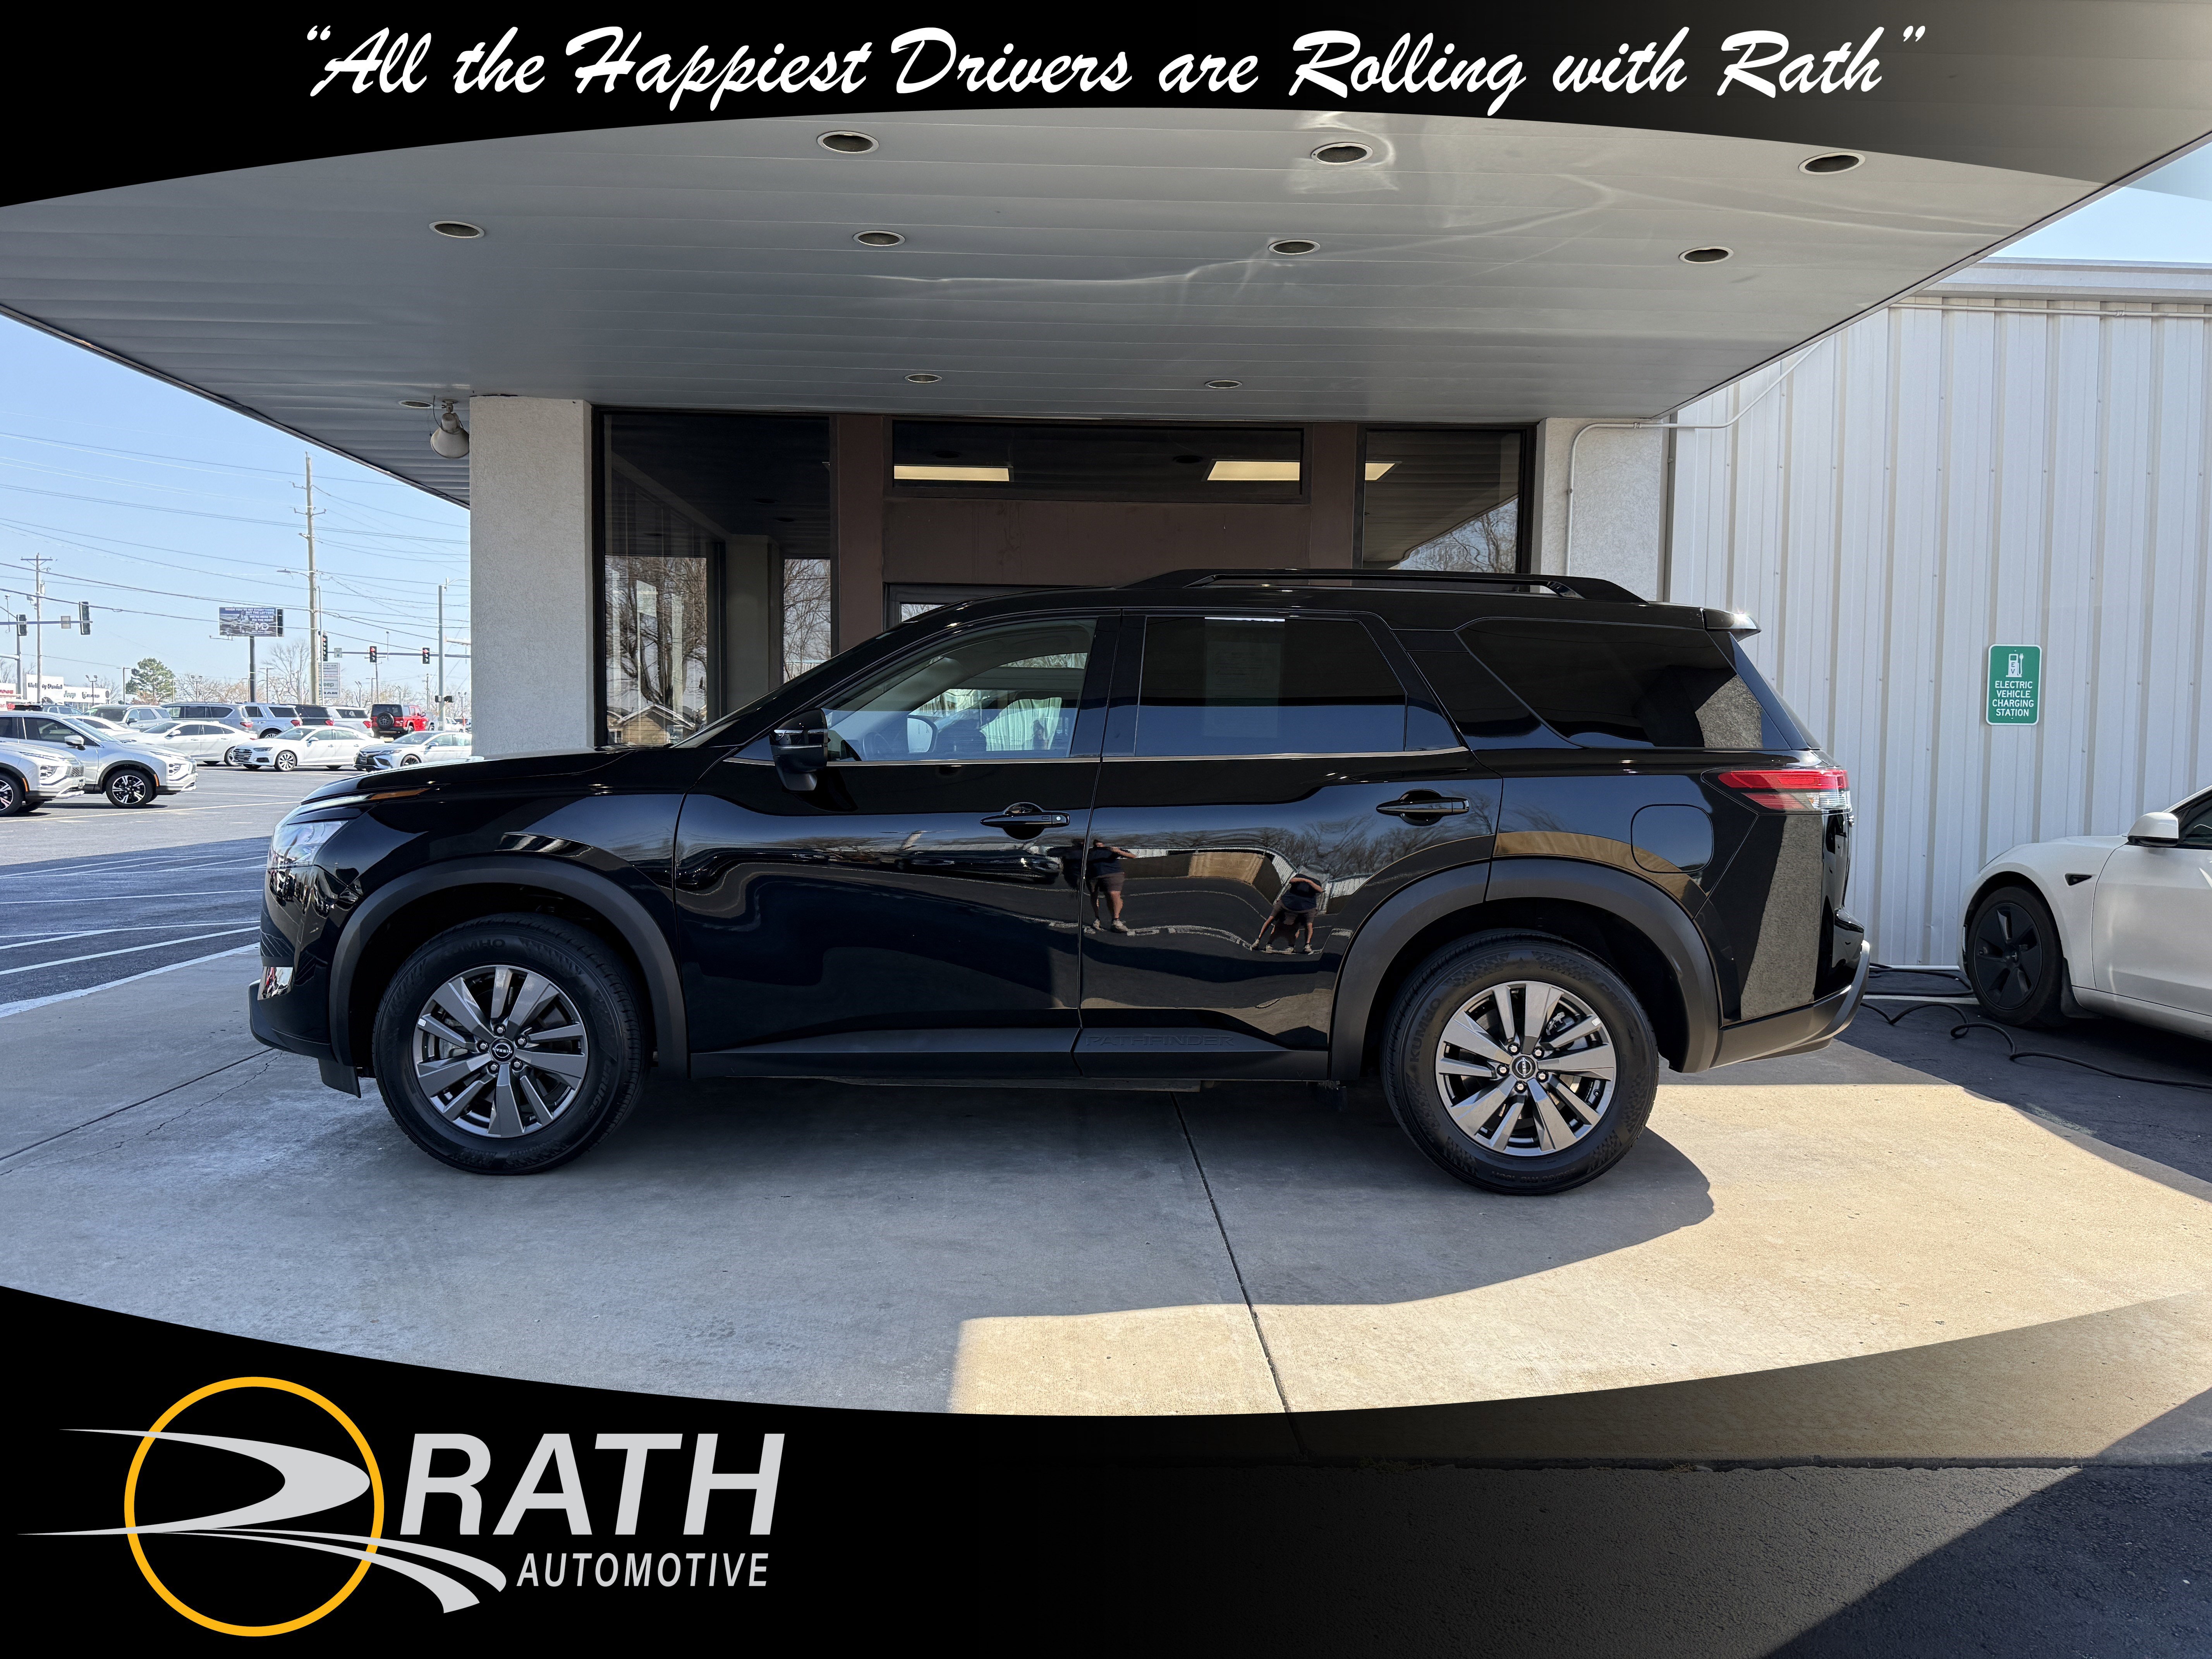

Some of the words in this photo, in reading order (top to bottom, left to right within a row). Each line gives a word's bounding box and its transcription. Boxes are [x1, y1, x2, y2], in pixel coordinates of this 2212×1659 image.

[1995, 680, 2033, 689] ELECTRIC
[1996, 690, 2031, 698] VEHICLE
[1992, 699, 2034, 708] CHARGING
[1996, 708, 2029, 717] STATION
[1410, 998, 1441, 1063] KUMHO
[1086, 1034, 1235, 1046] PATHFINDER
